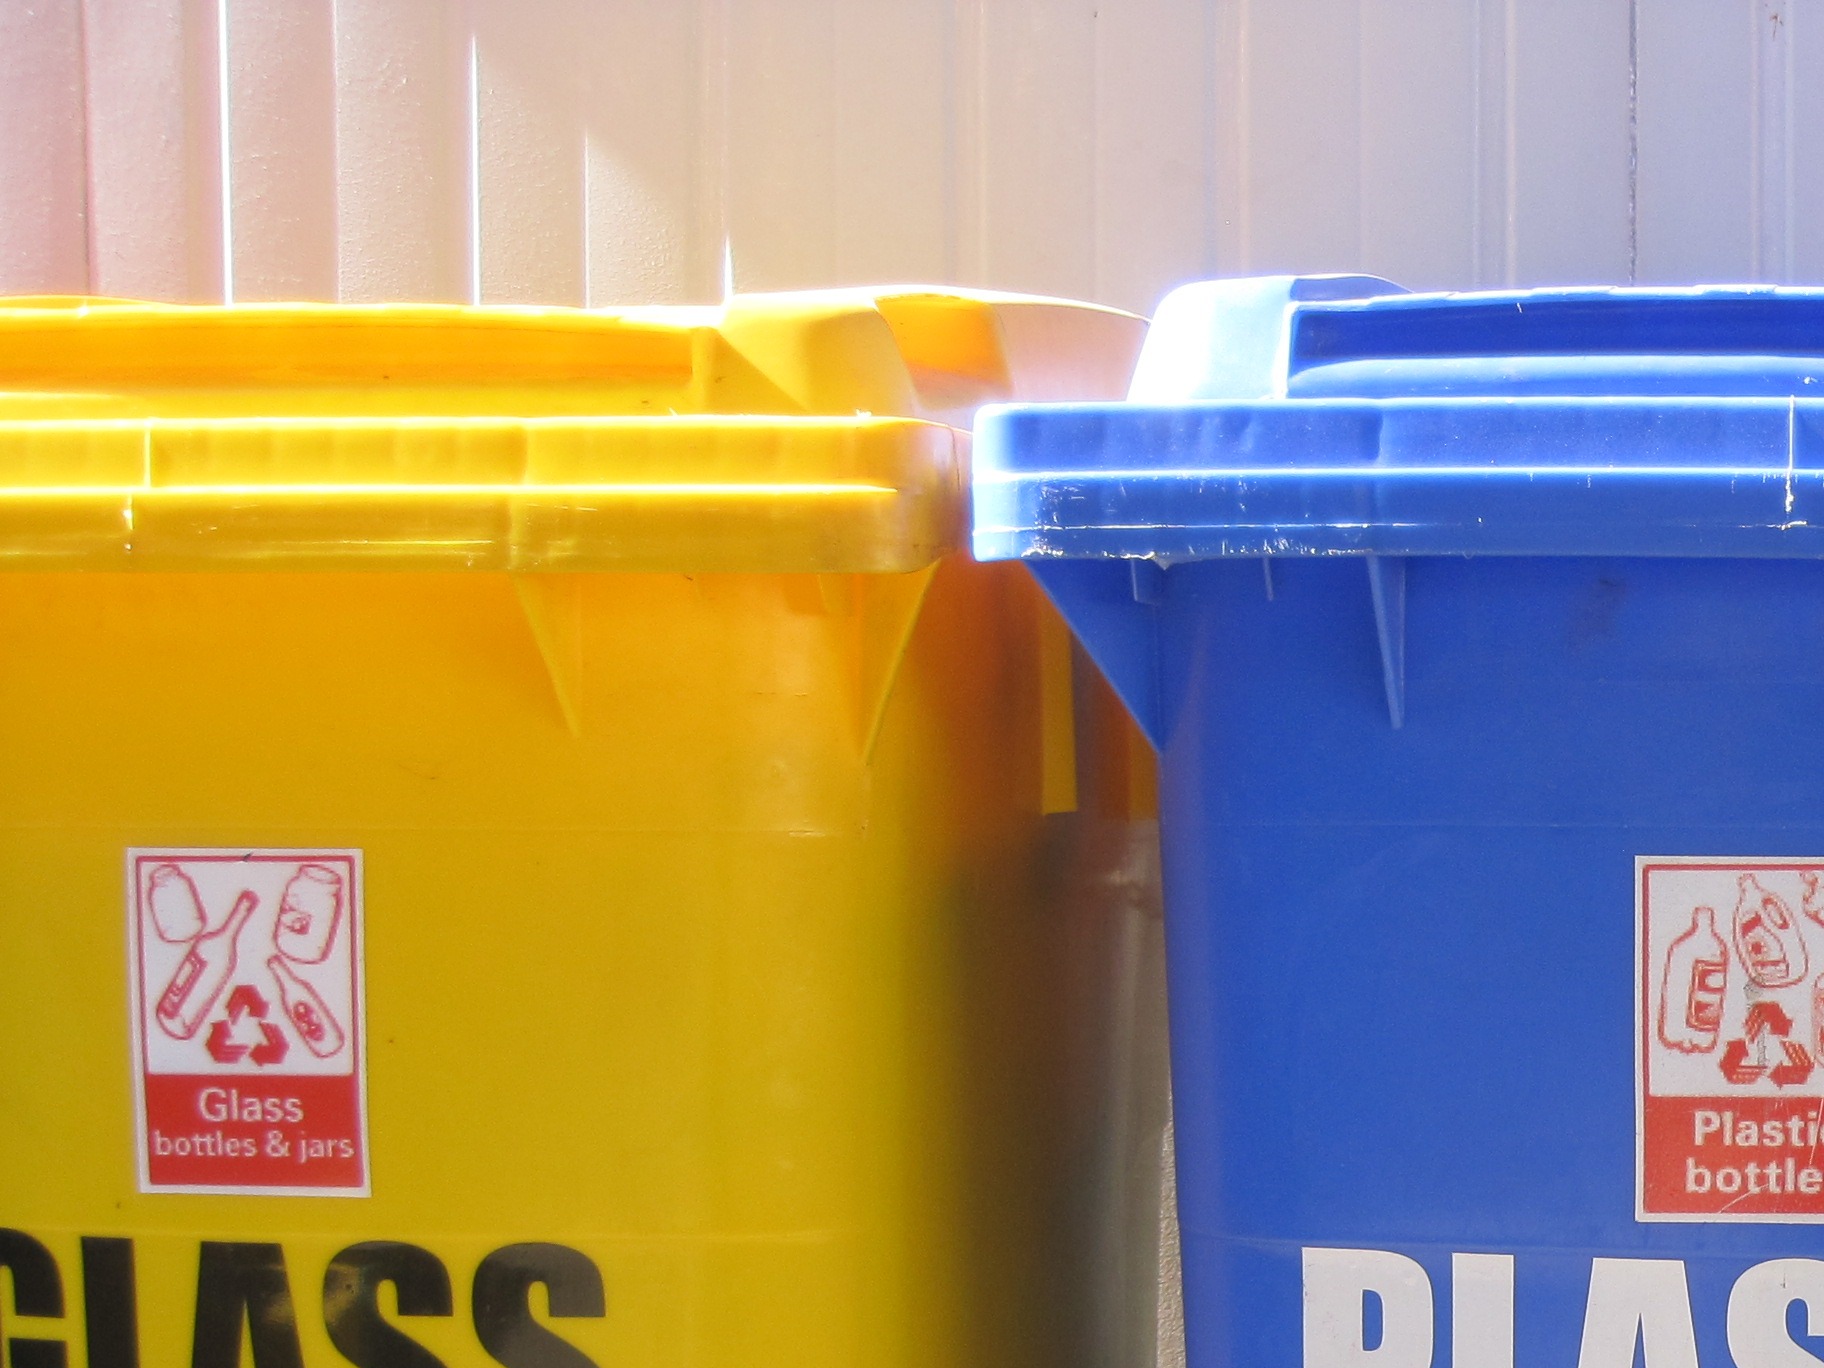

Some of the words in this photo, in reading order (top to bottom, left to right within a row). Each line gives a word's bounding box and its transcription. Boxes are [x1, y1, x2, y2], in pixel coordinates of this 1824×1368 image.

[198, 1086, 305, 1123] Glass
[154, 1129, 258, 1158] bottles
[265, 1129, 291, 1158] &
[299, 1135, 355, 1164] jars
